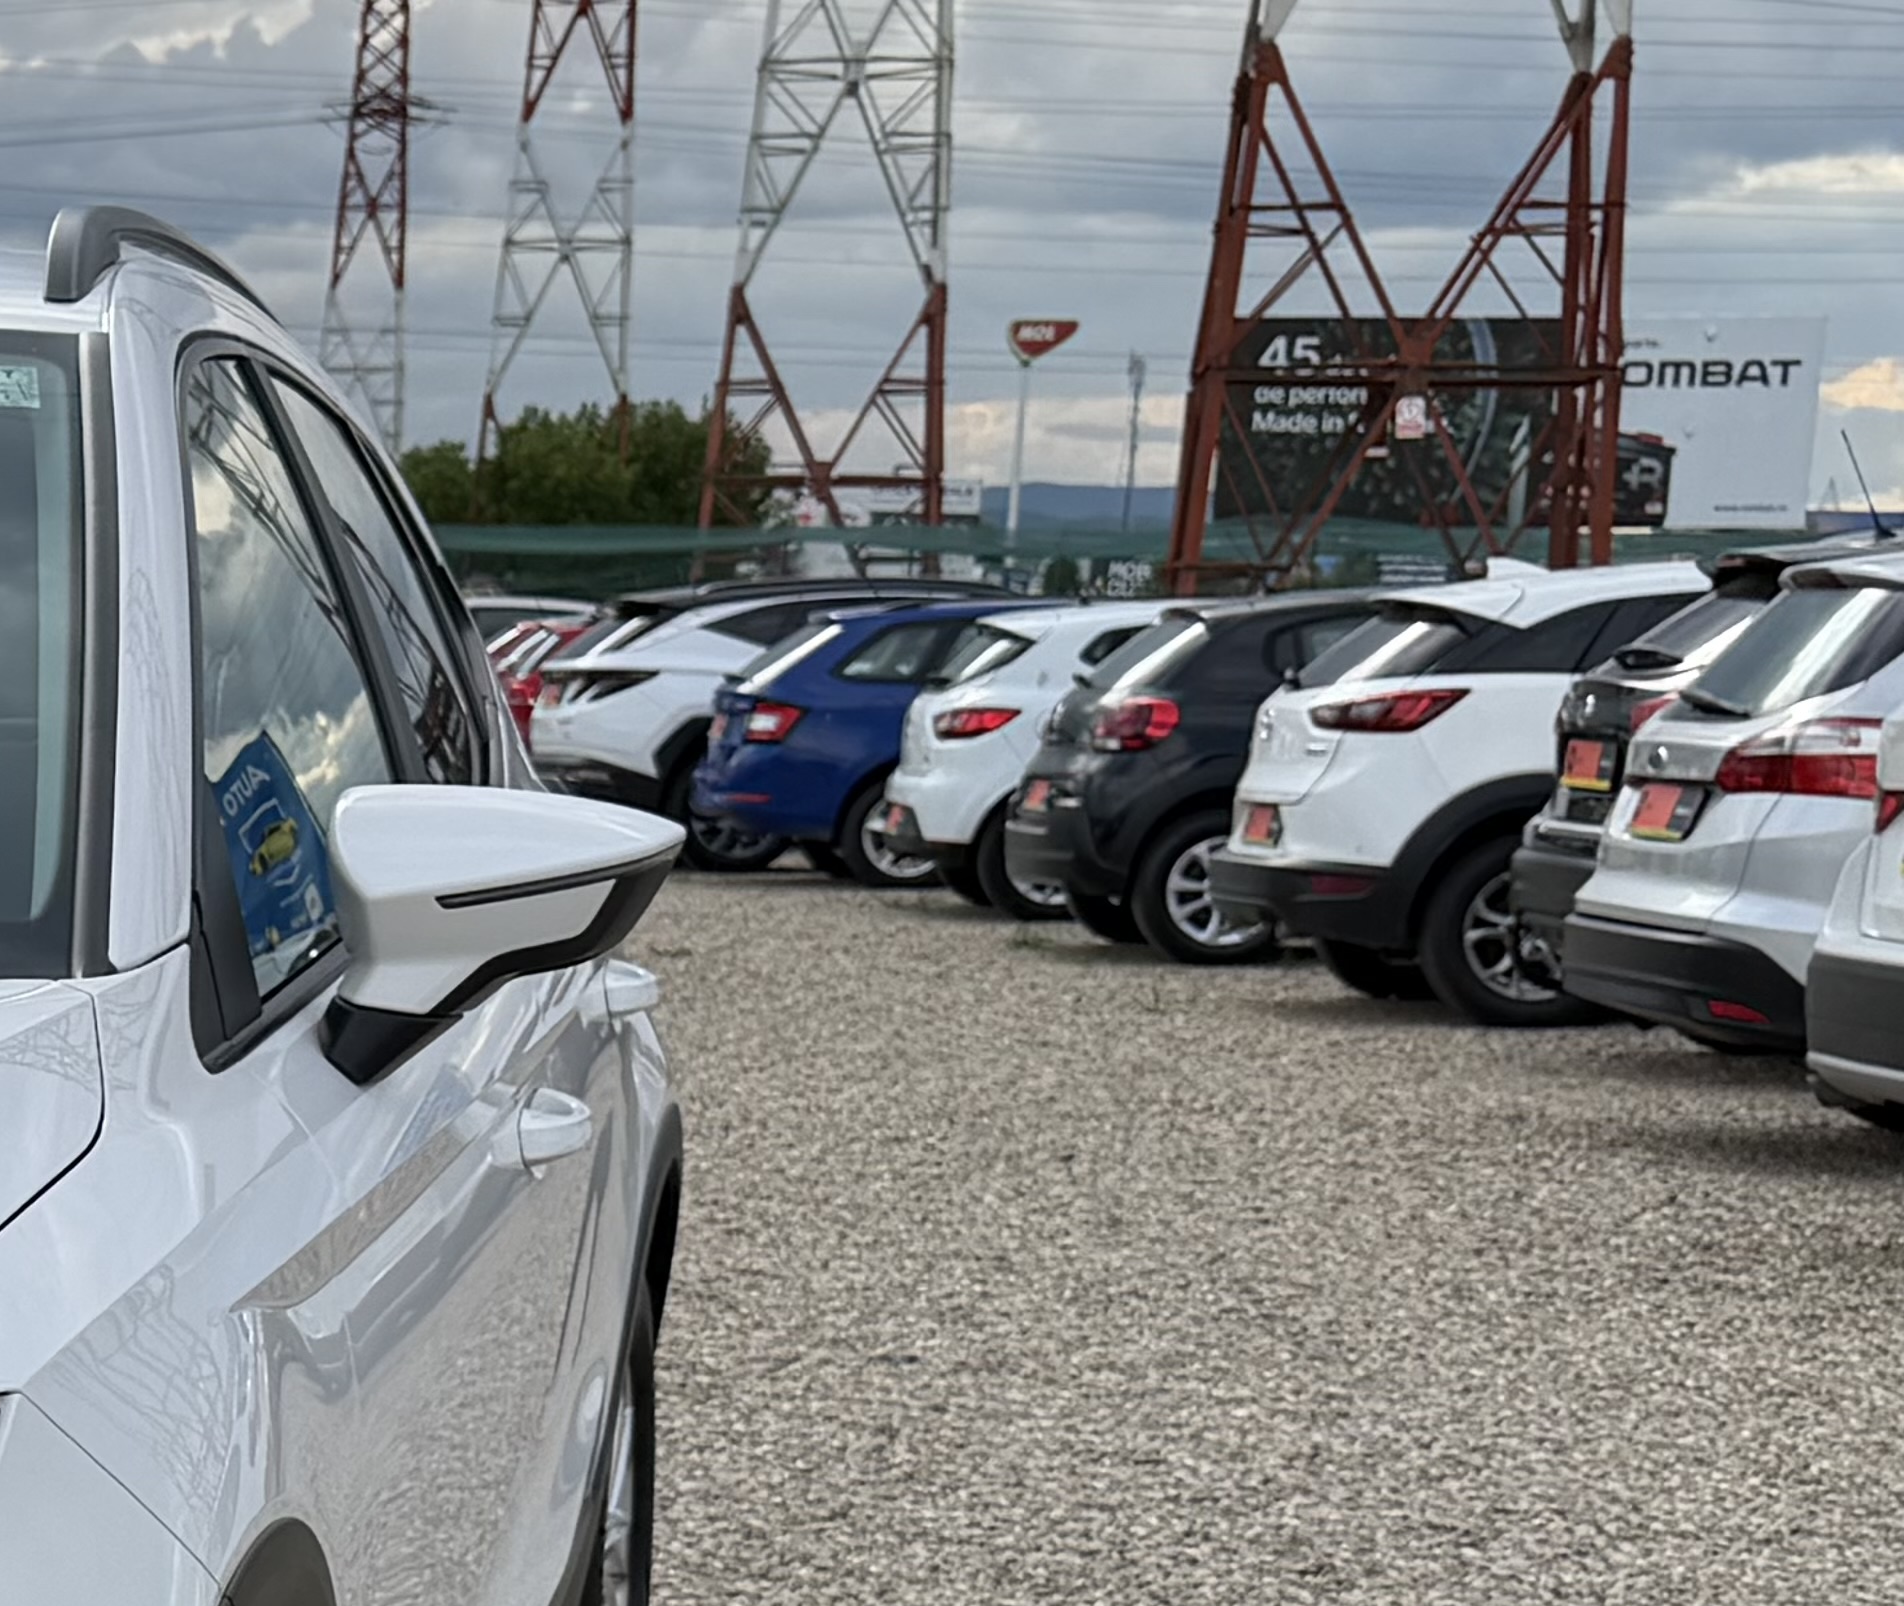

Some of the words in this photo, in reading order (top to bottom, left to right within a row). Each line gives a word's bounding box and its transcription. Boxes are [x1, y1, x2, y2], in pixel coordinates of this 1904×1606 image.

[1258, 335, 1321, 377] 45
[1620, 360, 1802, 389] OMBAT
[1252, 411, 1318, 433] Made
[1321, 411, 1345, 433] in
